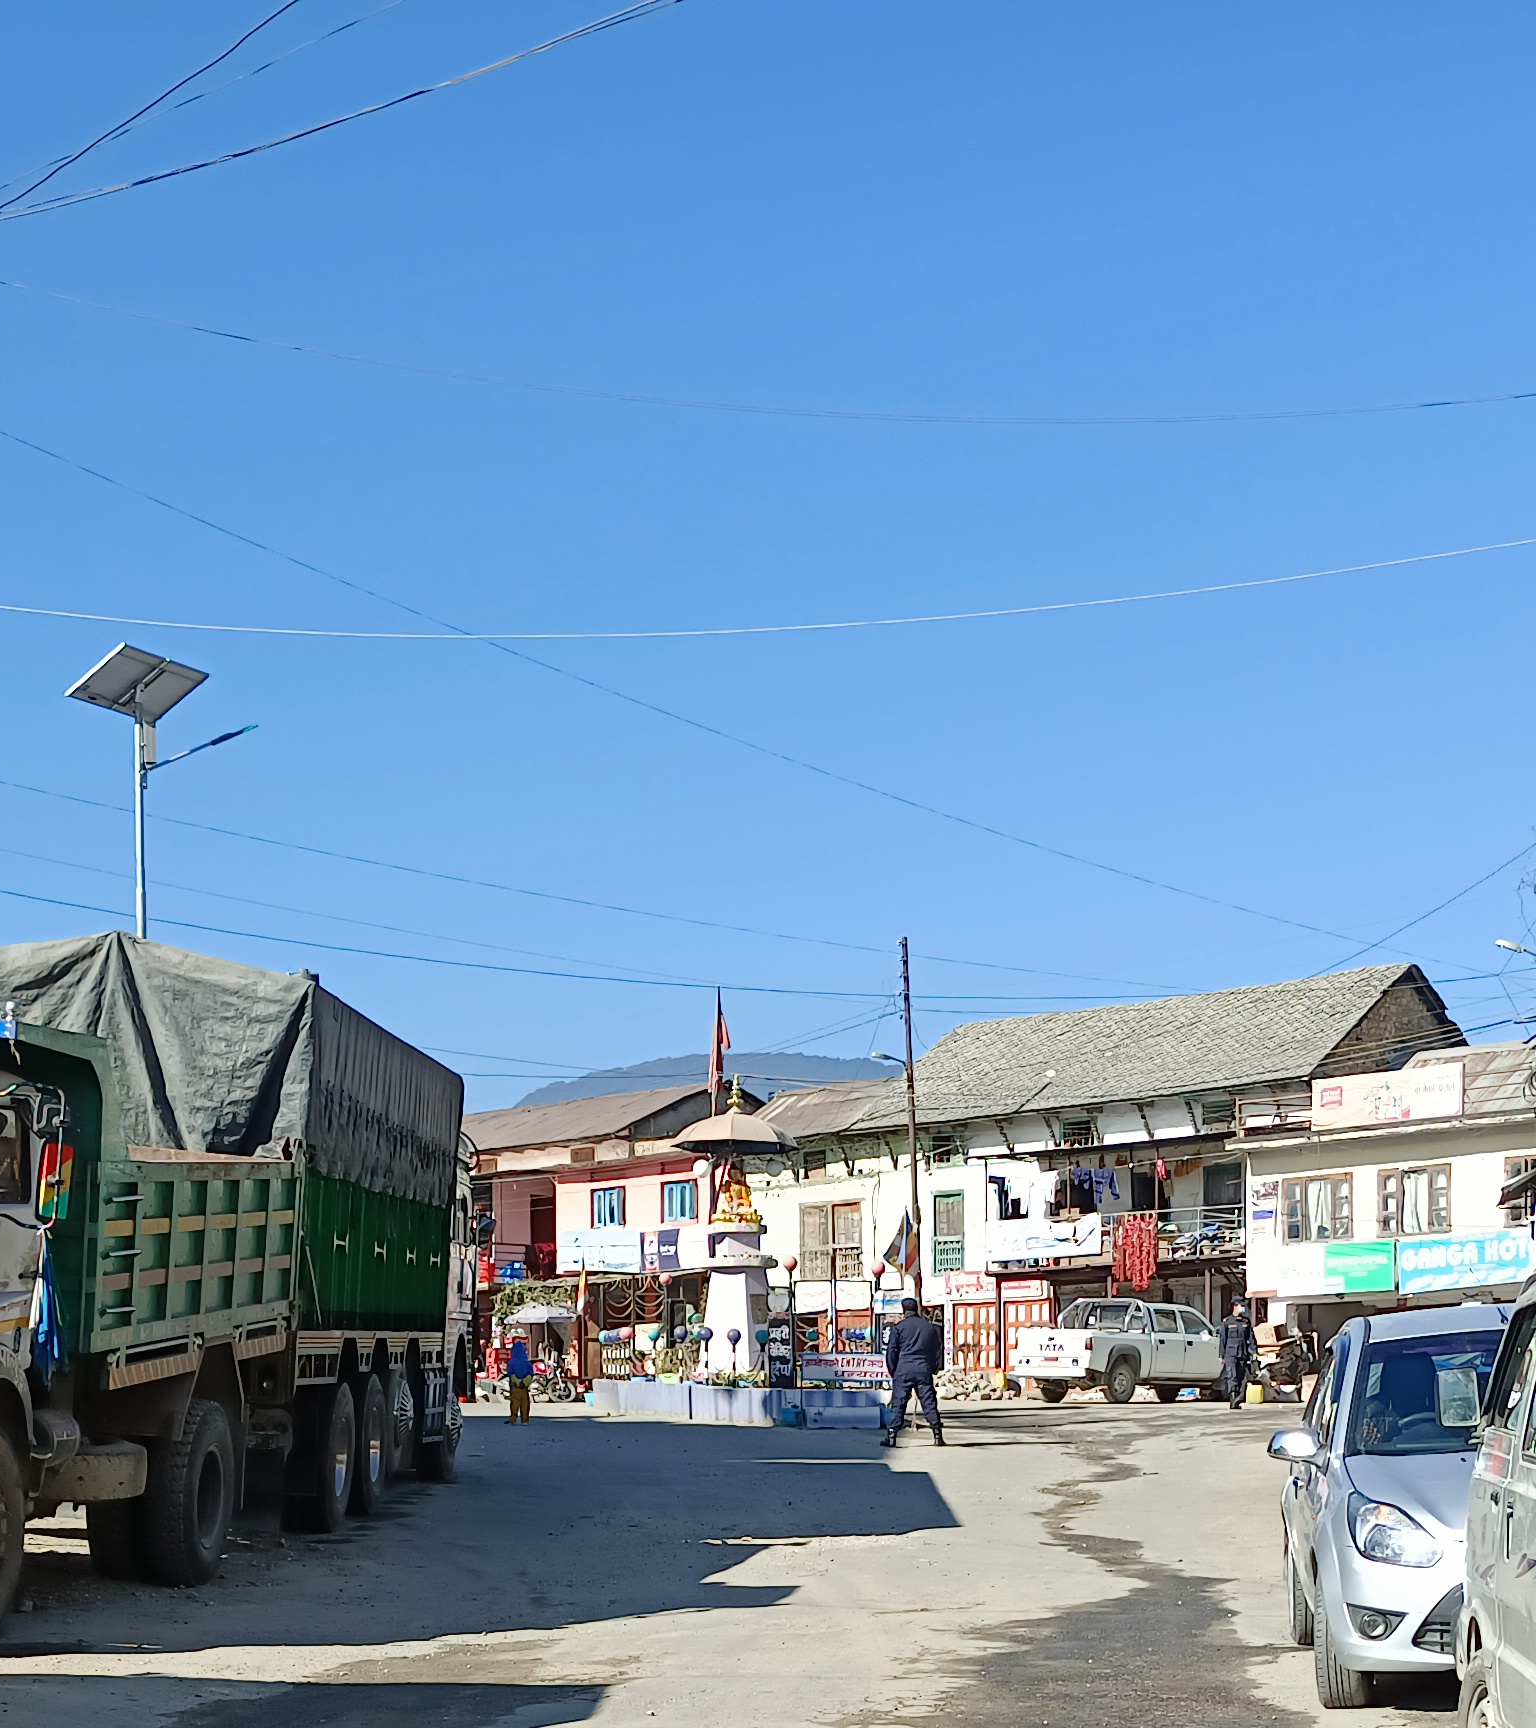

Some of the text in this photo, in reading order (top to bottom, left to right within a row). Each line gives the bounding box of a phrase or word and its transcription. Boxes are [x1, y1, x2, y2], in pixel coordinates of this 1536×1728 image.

[1400, 1243, 1479, 1272] GANGA
[1484, 1236, 1534, 1263] HOT
[1039, 1343, 1065, 1352] TATA
